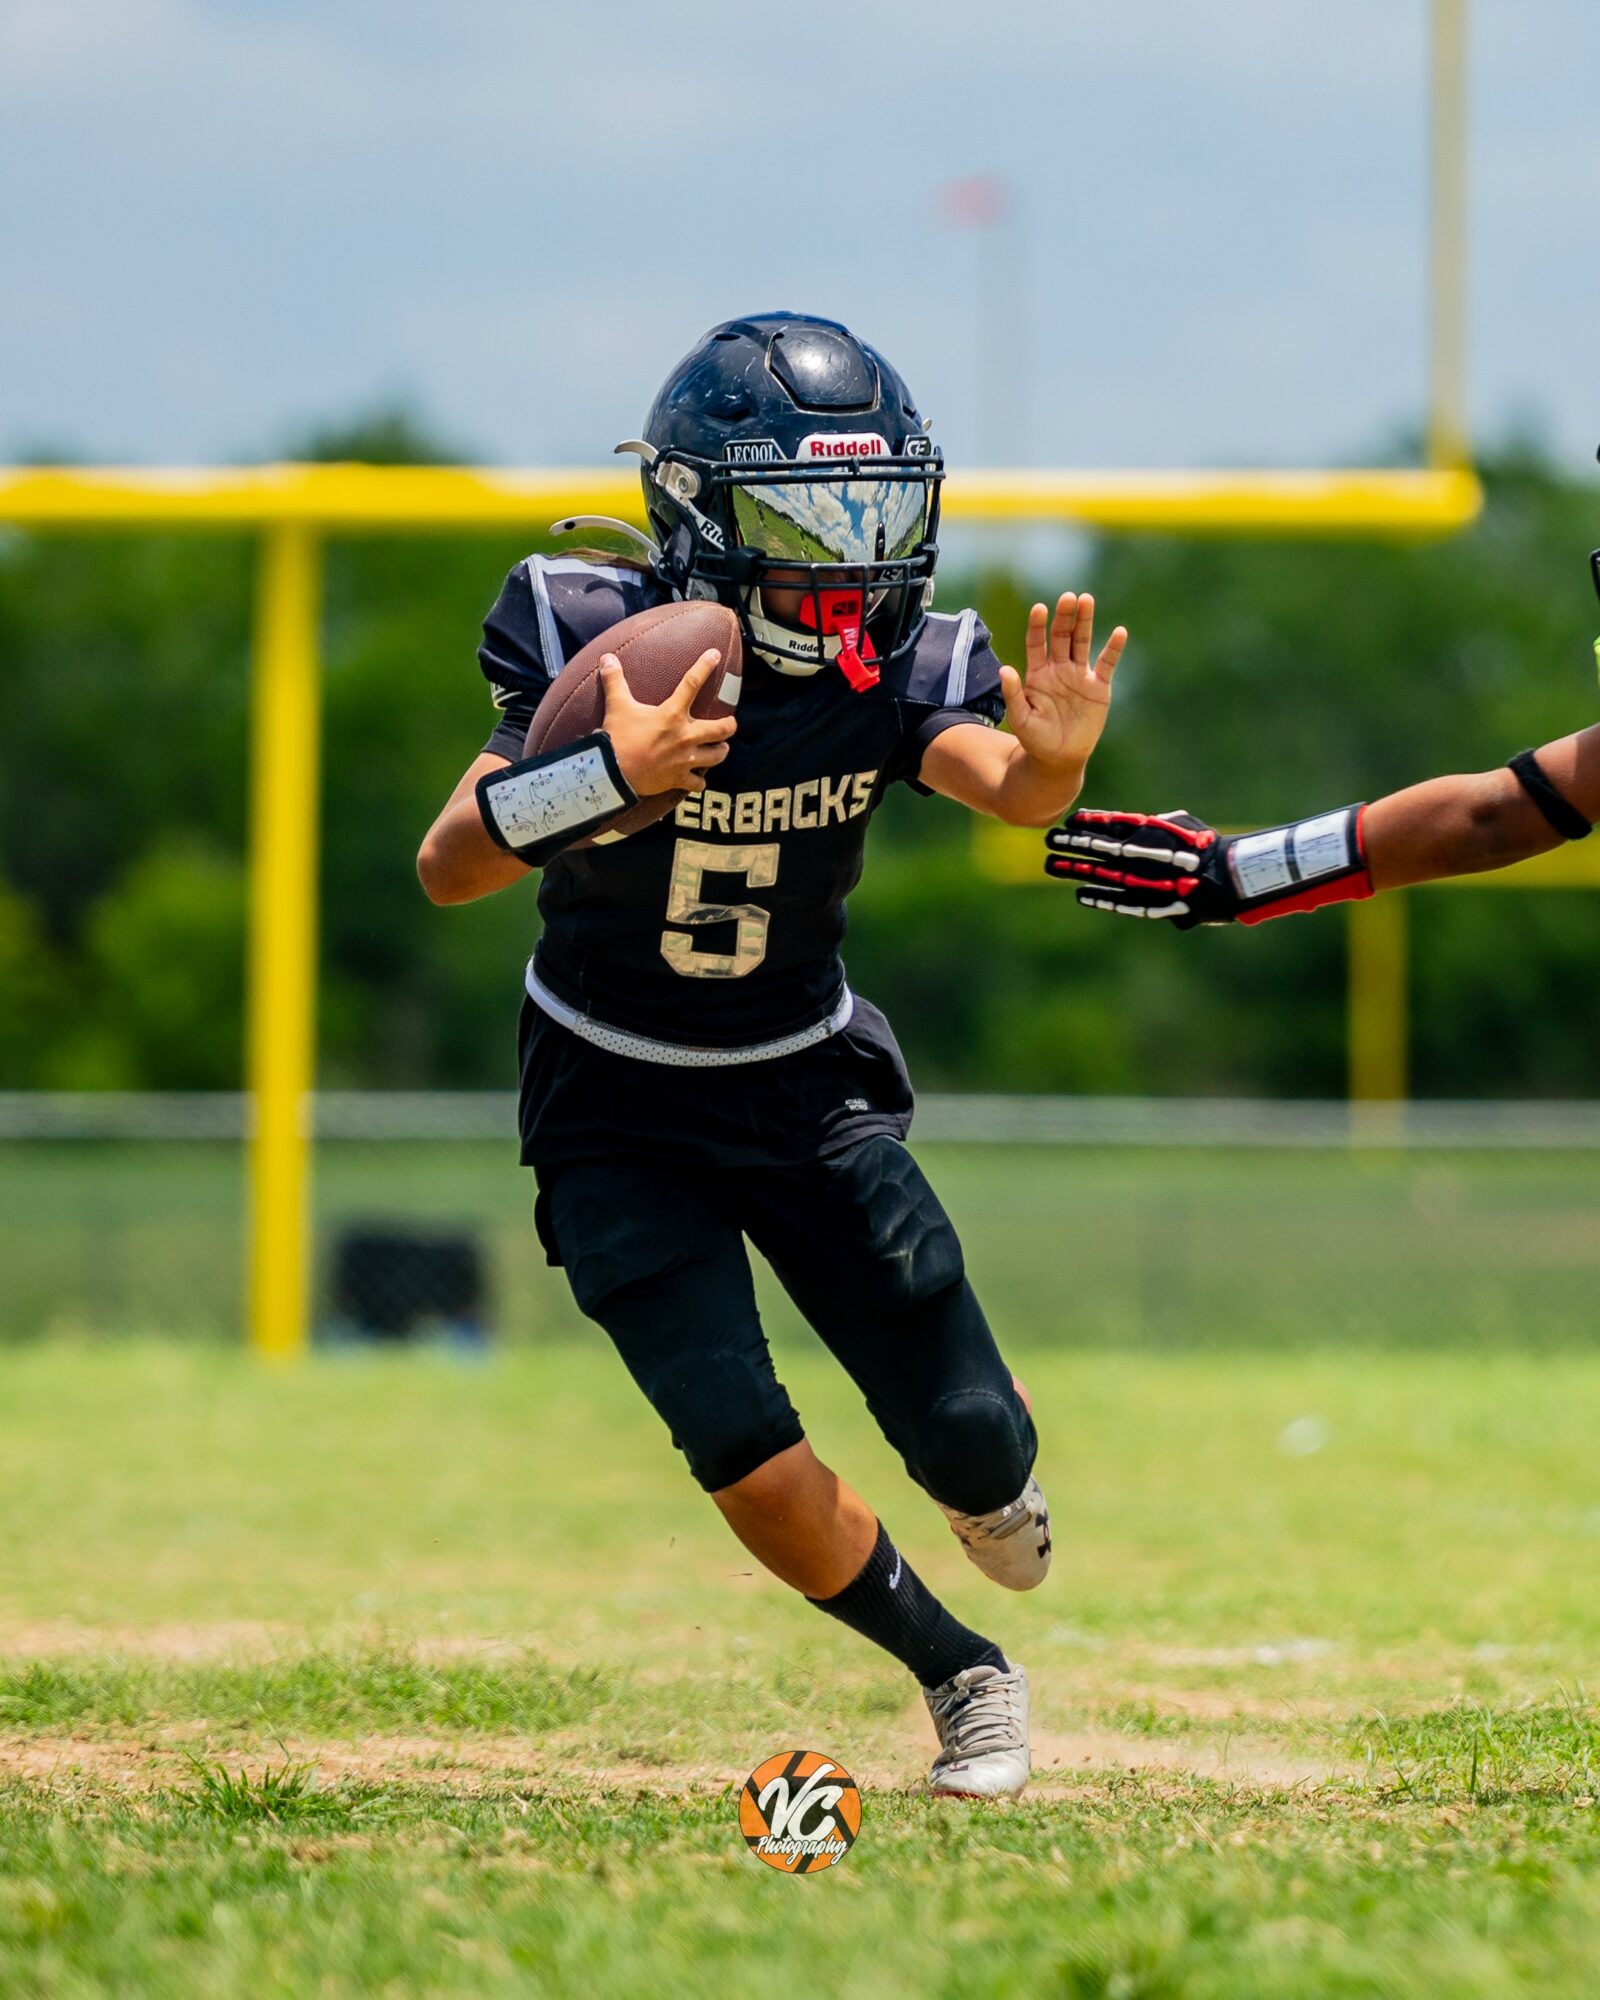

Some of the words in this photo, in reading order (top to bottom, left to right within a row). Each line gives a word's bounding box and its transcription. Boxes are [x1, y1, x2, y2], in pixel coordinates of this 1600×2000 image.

[810, 440, 881, 456] Riddell
[788, 639, 825, 653] Ridde
[674, 769, 878, 833] ERBACKS
[660, 837, 780, 979] 5
